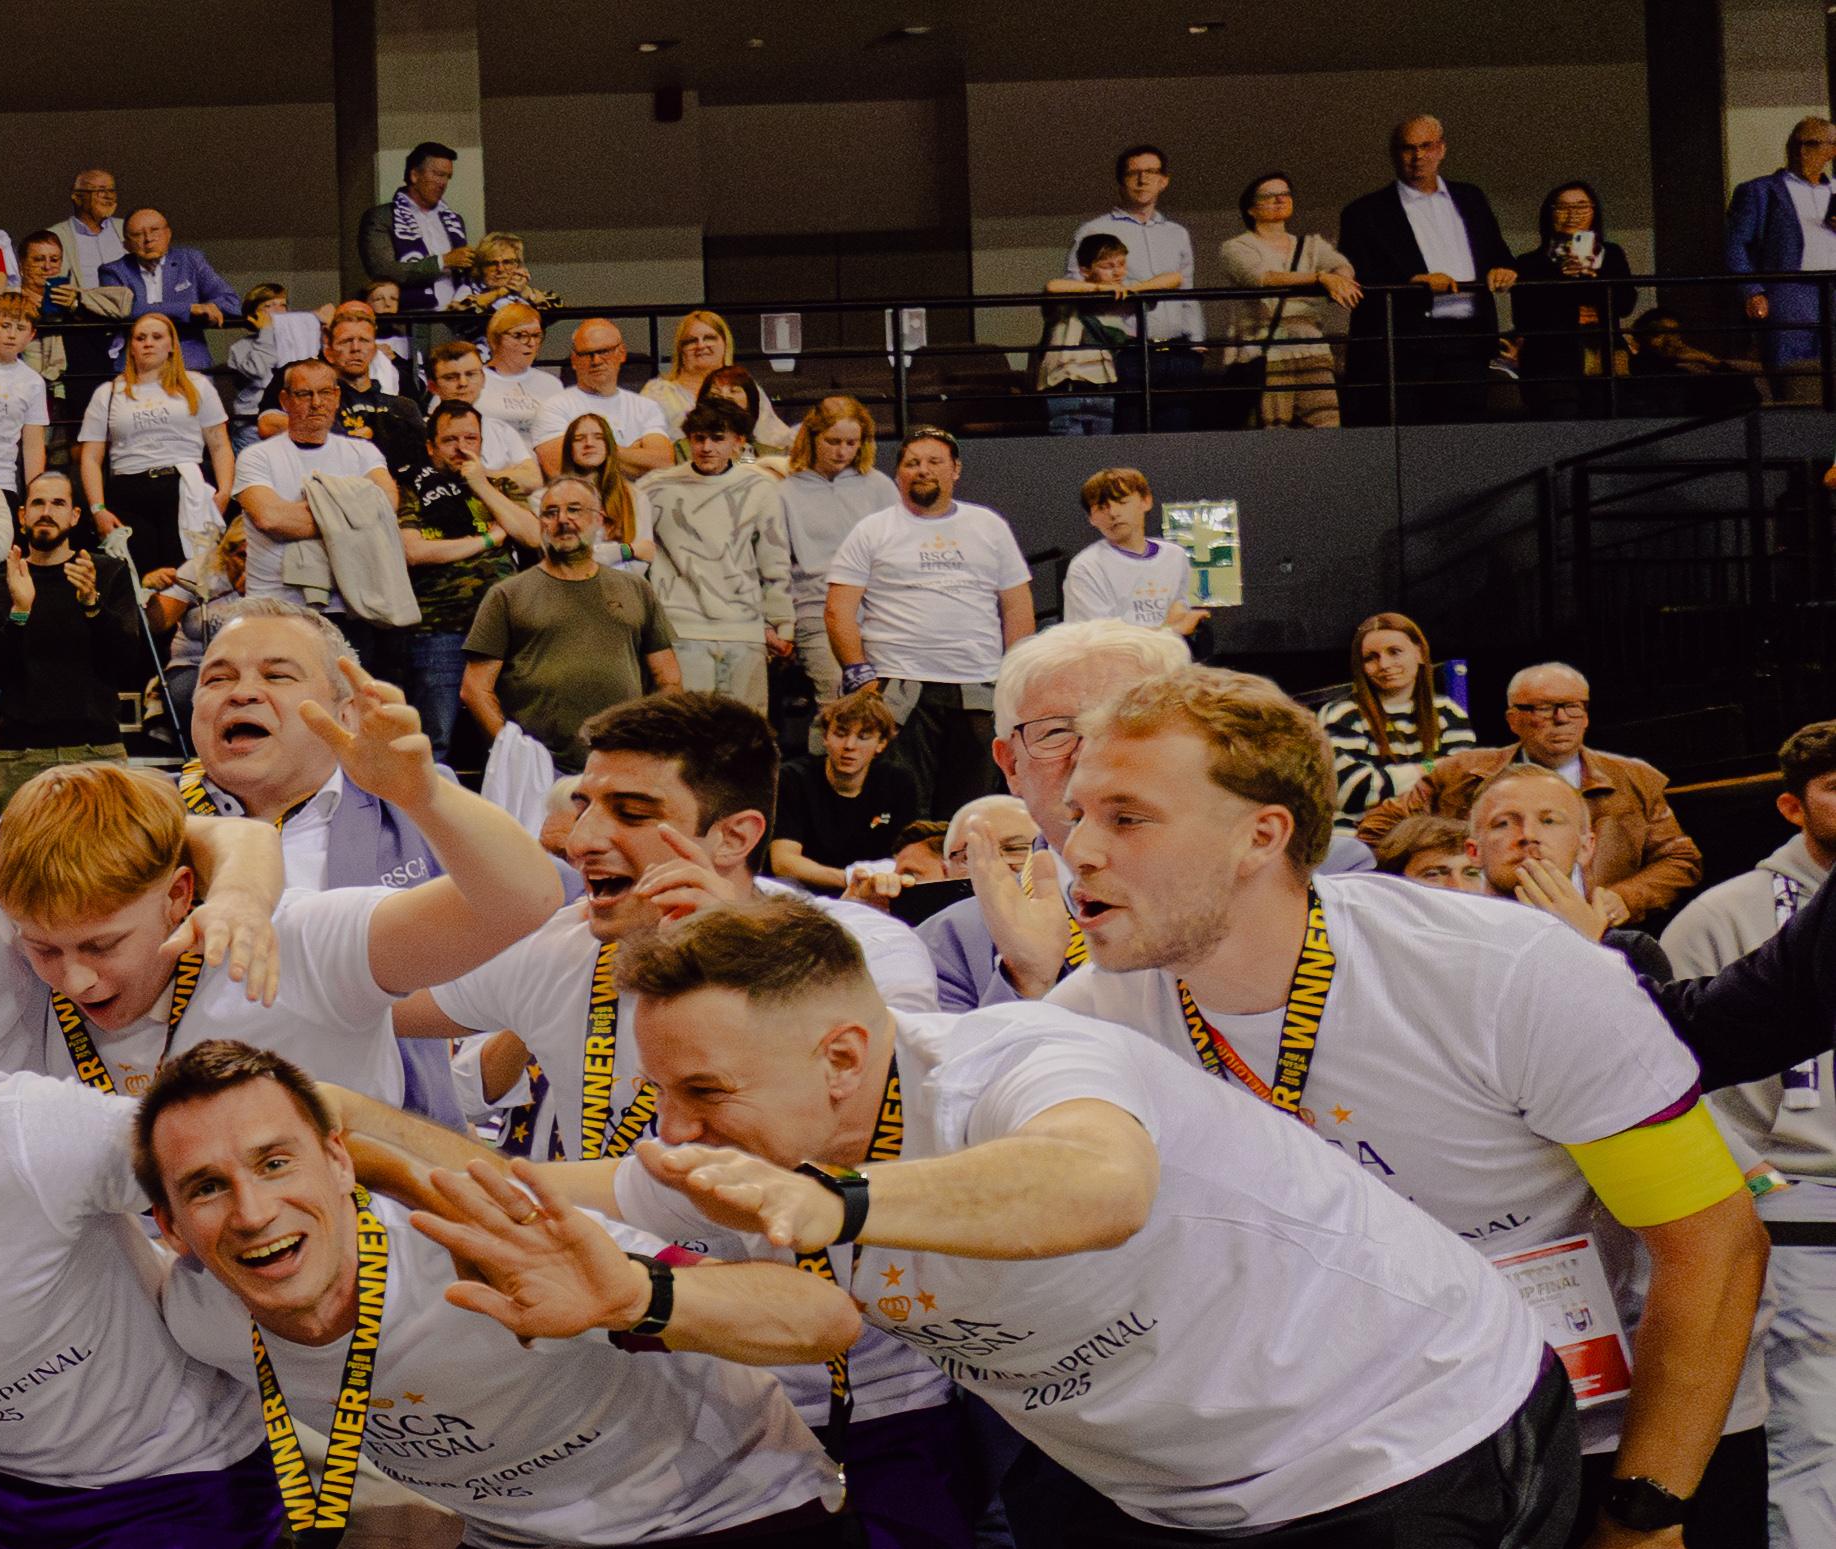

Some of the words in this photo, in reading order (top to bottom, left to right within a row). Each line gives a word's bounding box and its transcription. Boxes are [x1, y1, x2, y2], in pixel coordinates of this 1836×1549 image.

[1132, 600, 1166, 613] RSC
[582, 1036, 616, 1160] WINNER
[351, 1211, 389, 1350] WINNER
[1022, 1371, 1093, 1412] 2025
[263, 1394, 317, 1532] WINNER
[314, 1387, 370, 1529] WINNER
